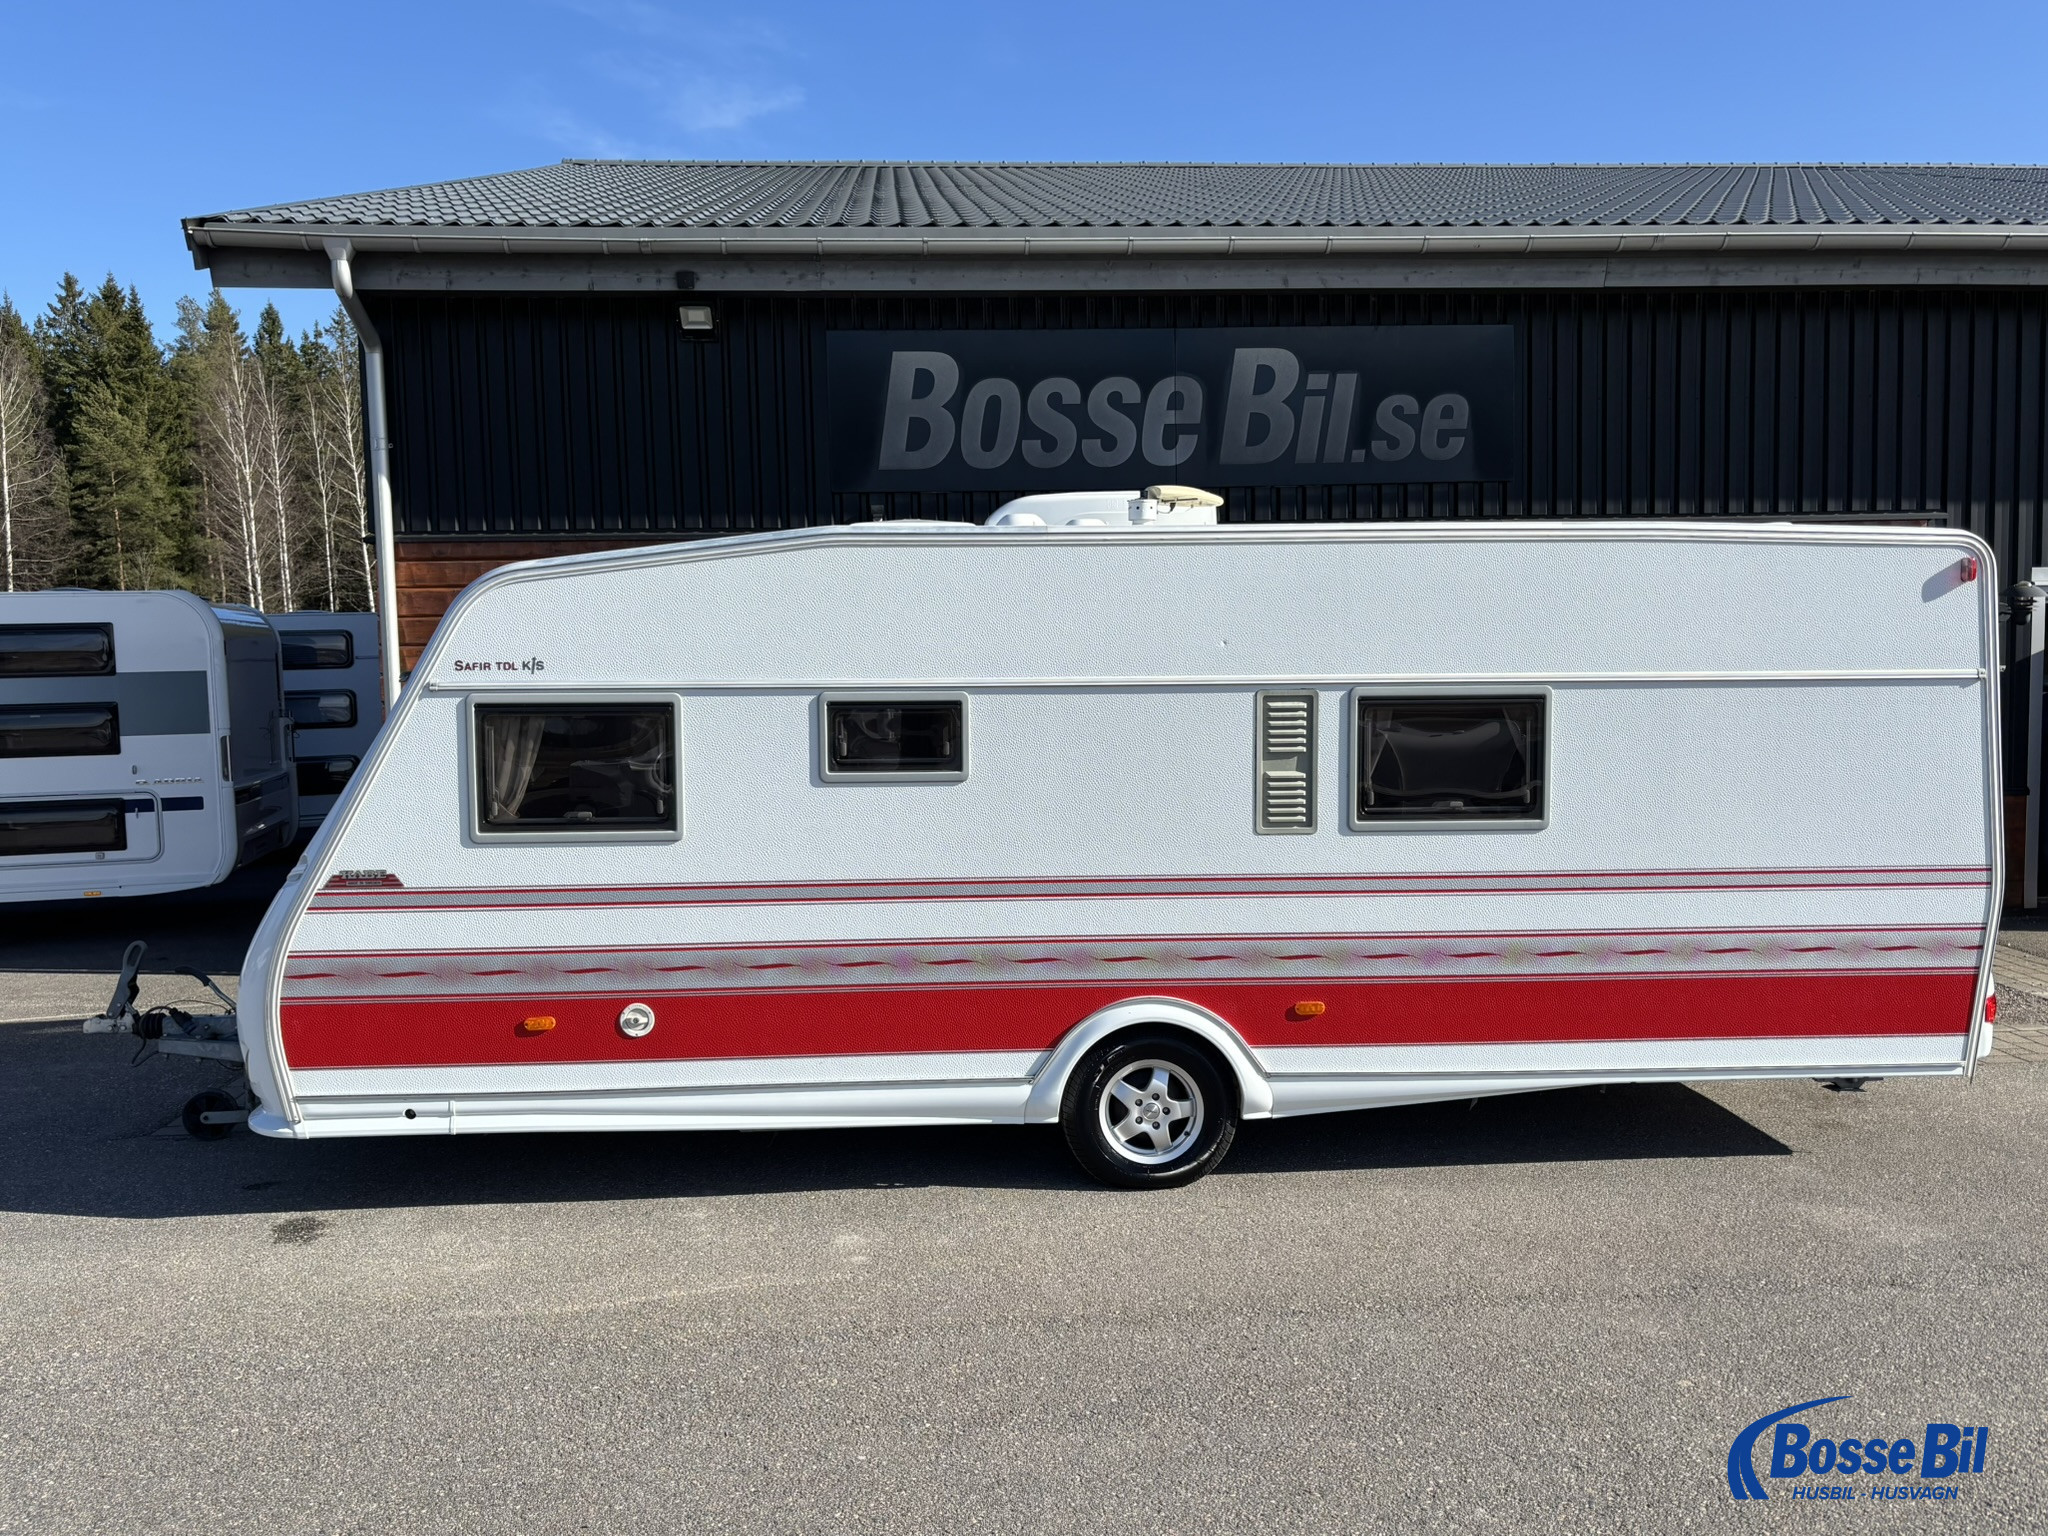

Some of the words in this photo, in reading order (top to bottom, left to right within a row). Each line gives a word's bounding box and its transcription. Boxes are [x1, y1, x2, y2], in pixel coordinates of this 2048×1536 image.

[878, 350, 1203, 471] Bosse
[1219, 347, 1470, 465] Bil.se
[454, 659, 491, 671] SAFIR
[496, 661, 518, 671] TDL
[339, 869, 387, 879] KABE
